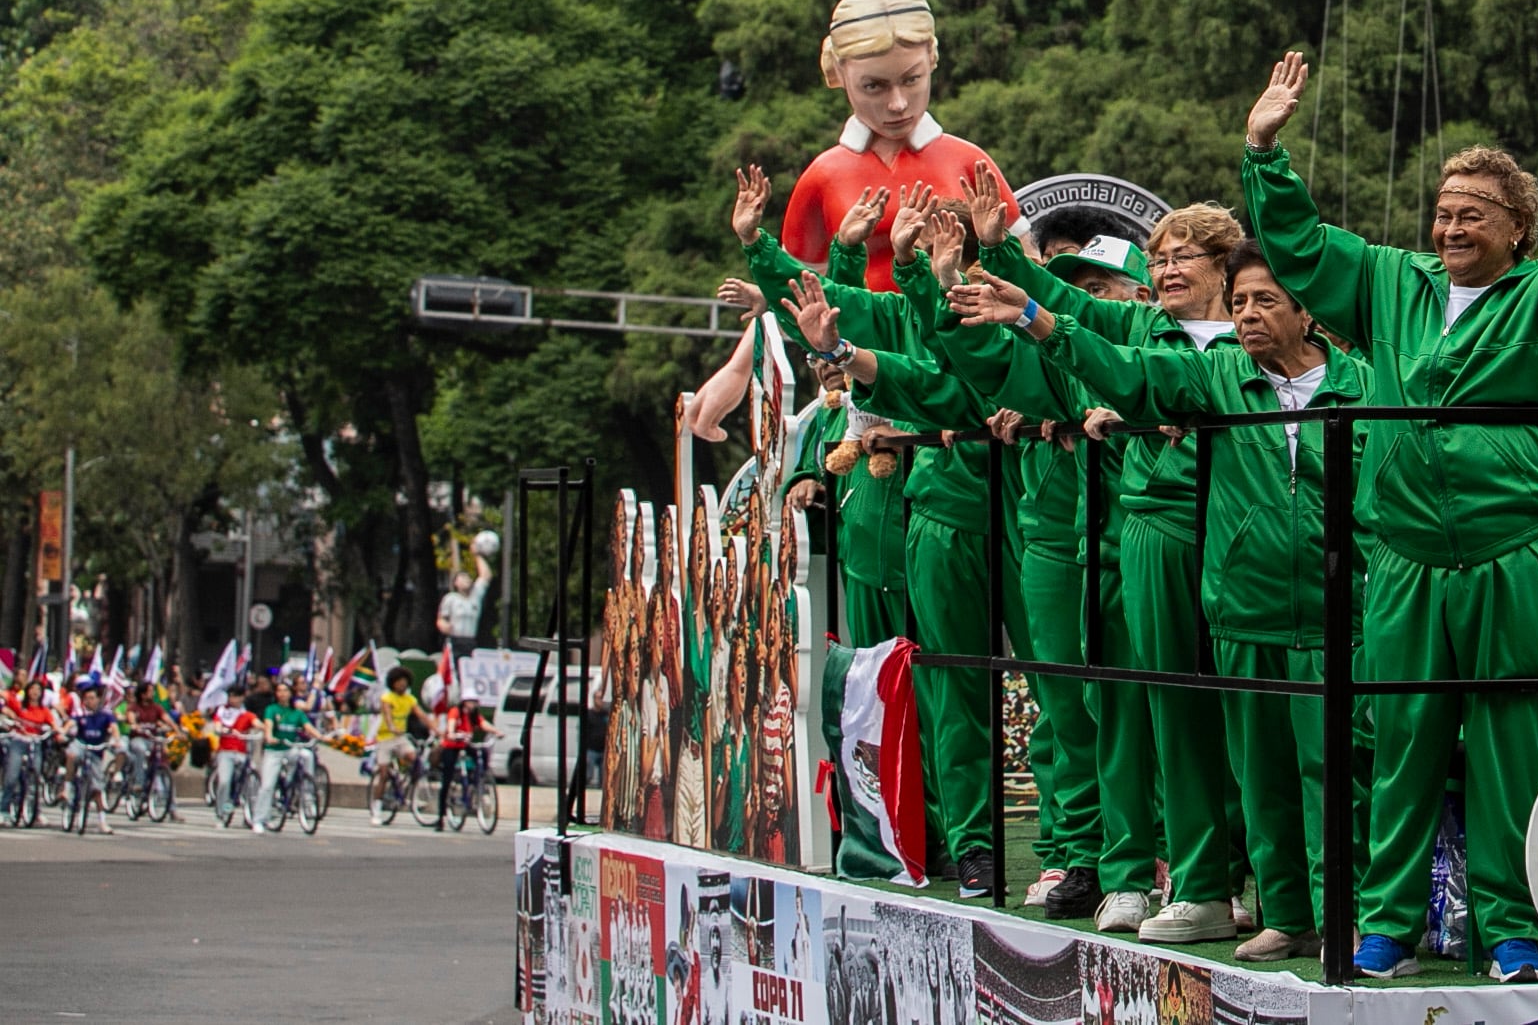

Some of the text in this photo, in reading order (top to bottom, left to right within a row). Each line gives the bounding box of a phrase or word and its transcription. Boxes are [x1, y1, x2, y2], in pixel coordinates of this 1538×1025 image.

[1039, 182, 1145, 215] mundial de
[753, 970, 804, 1022] COPA 71
